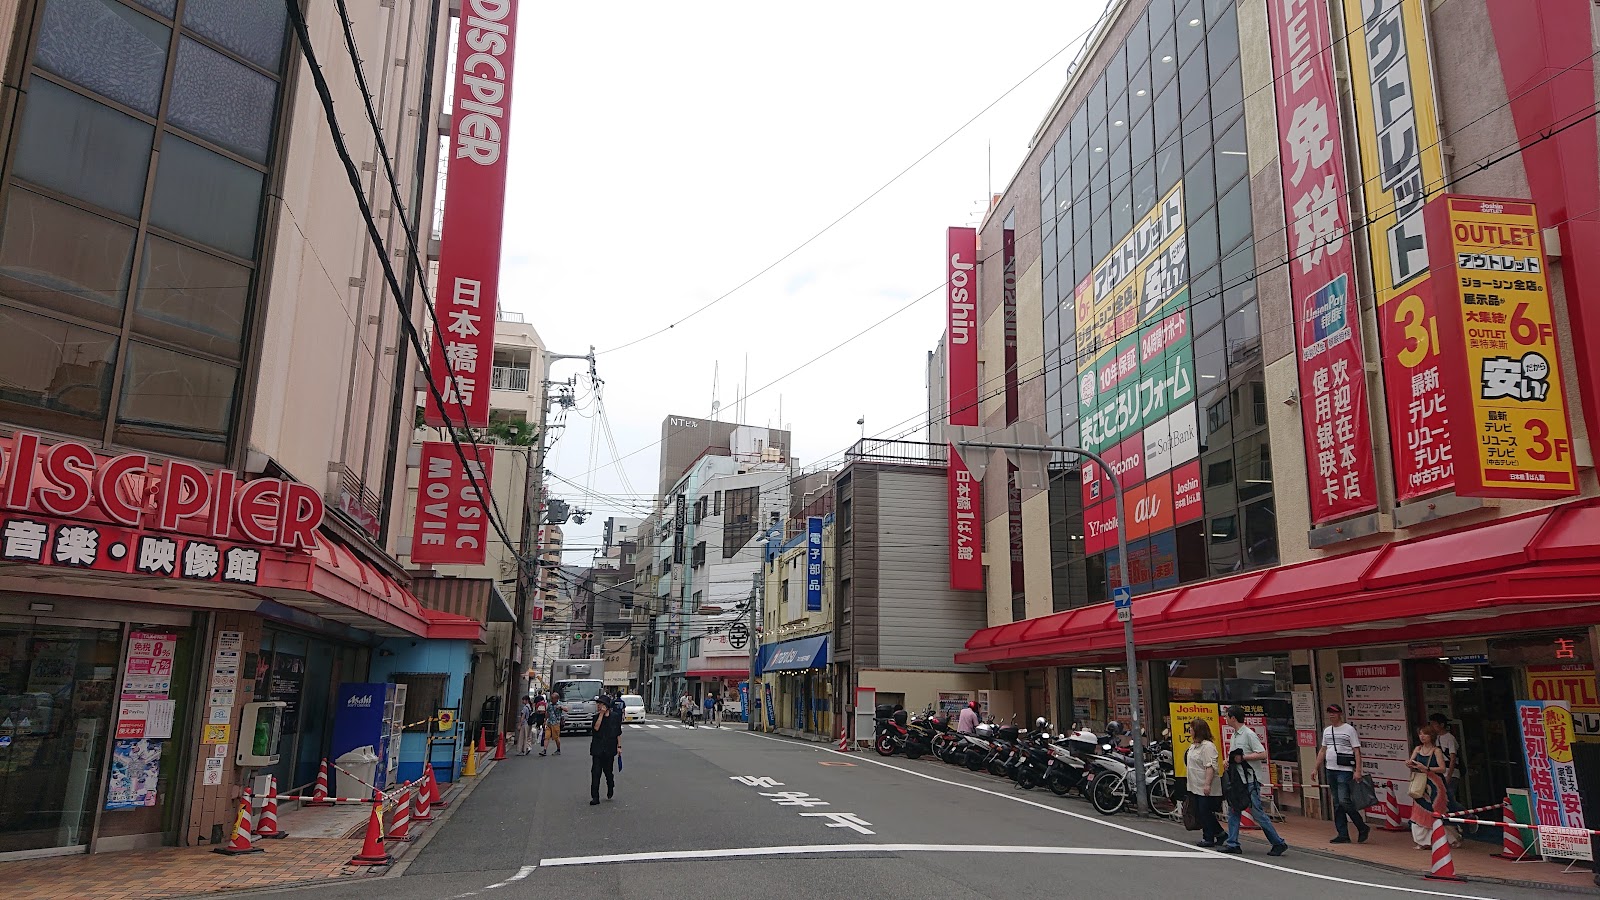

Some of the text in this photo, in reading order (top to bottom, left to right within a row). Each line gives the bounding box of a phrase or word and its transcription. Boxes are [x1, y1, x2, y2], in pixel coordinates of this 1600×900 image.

[1286, 97, 1344, 275] 免税
[1480, 202, 1504, 210] Joshin
[1096, 195, 1180, 300] アウトレット
[1454, 223, 1536, 247] OUTLET
[1459, 254, 1539, 272] アウトレット
[951, 253, 974, 345] Joshin
[1461, 277, 1544, 292] ジョーシン全店の
[1305, 291, 1345, 323] UnionPay
[1321, 307, 1342, 329] 银联
[1465, 310, 1508, 325] 大集結!
[1142, 313, 1186, 361] 24時間サポート
[1468, 328, 1507, 340] OUTLET
[1509, 302, 1553, 346] 6F
[442, 277, 481, 406] 日本橋店
[1470, 338, 1509, 351] 奥特莱斯
[1100, 347, 1137, 390] 10年保証
[1411, 366, 1440, 398] 最新
[1481, 357, 1549, 401] 安い!
[1525, 362, 1546, 372] だから
[1082, 356, 1191, 451] まごころリフォーム
[1488, 411, 1508, 422] 最新
[1157, 424, 1195, 455] SoftBank
[1312, 368, 1340, 505] 使用银联卡
[1333, 358, 1361, 500] 欢迎在本店
[1482, 435, 1518, 447] リユース
[1484, 423, 1513, 433] テレビ
[1524, 418, 1569, 462] 3F
[1487, 447, 1516, 458] テレビ
[421, 456, 453, 546] MOVIE
[1175, 477, 1199, 495] Joshin
[455, 460, 485, 549] MUSIC
[956, 470, 976, 561] 日本橋1ばん館
[1135, 494, 1161, 523] au
[4, 520, 261, 583] 音楽・映像館
[809, 532, 821, 591] 電子部品
[348, 695, 373, 704] Asahi
[1521, 706, 1560, 826] 猛烈特価
